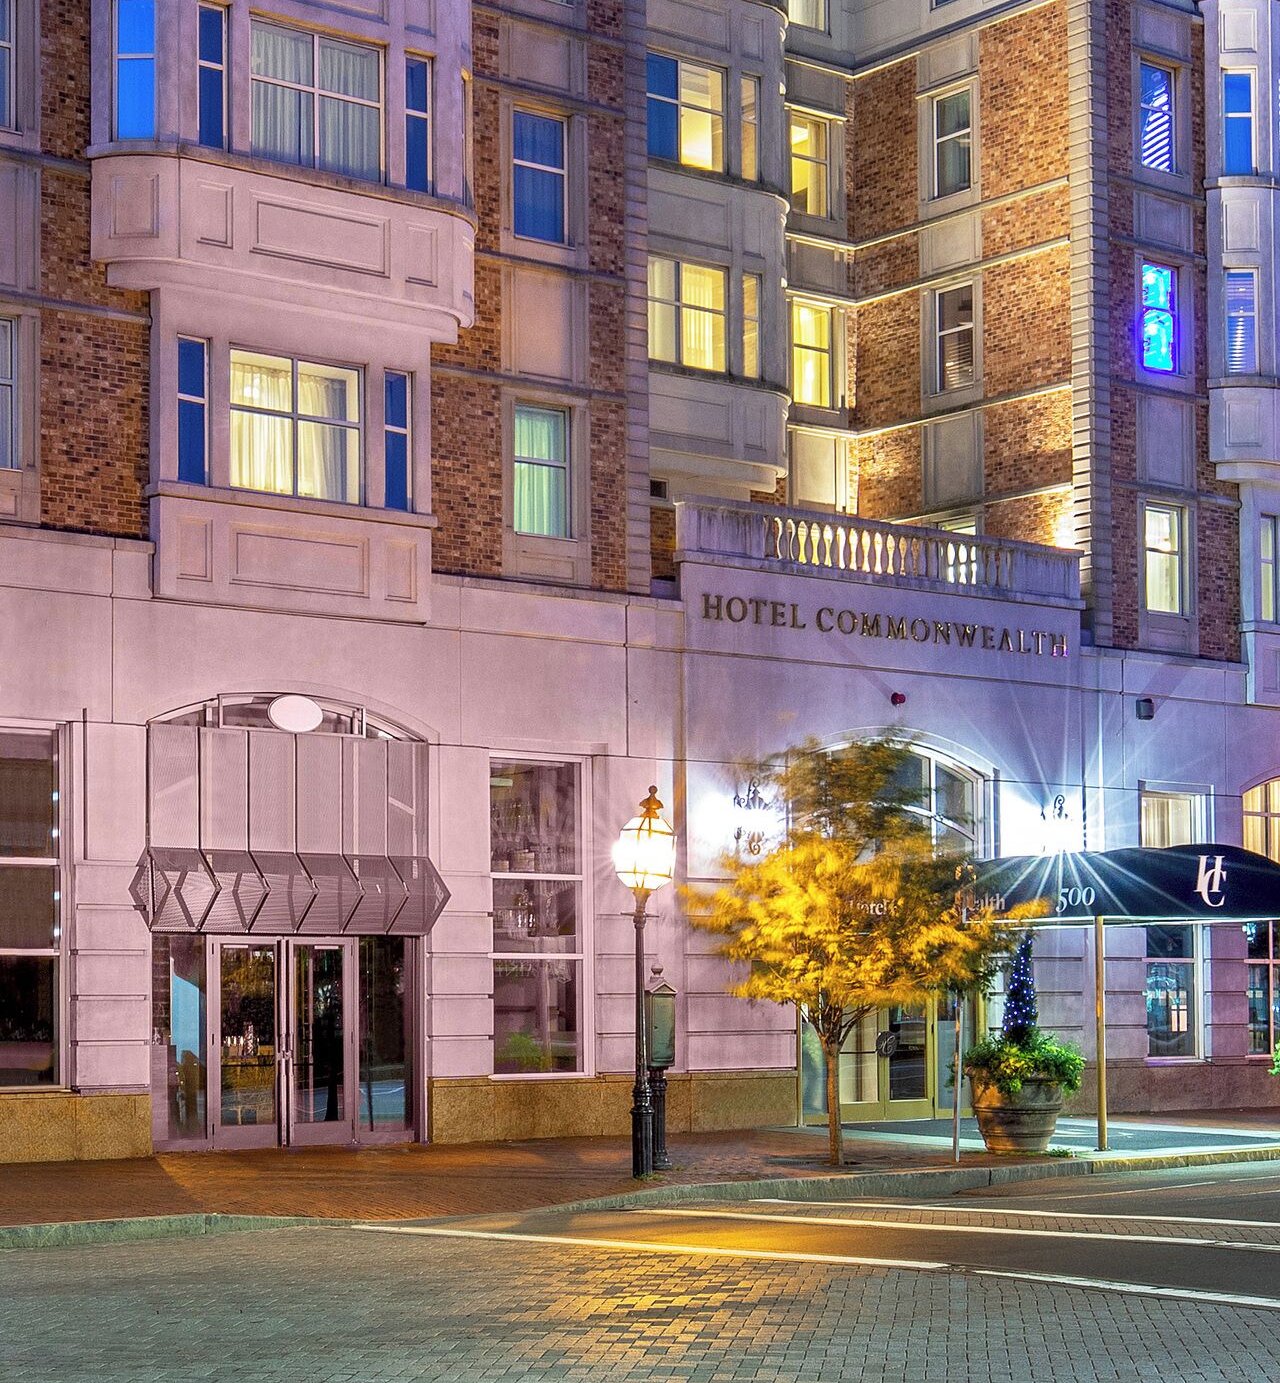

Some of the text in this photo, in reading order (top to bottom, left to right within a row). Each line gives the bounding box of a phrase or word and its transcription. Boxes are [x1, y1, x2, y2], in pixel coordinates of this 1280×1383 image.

[702, 593, 1068, 658] HOTEL COMMONWEALTH
[1056, 886, 1096, 912] 500
